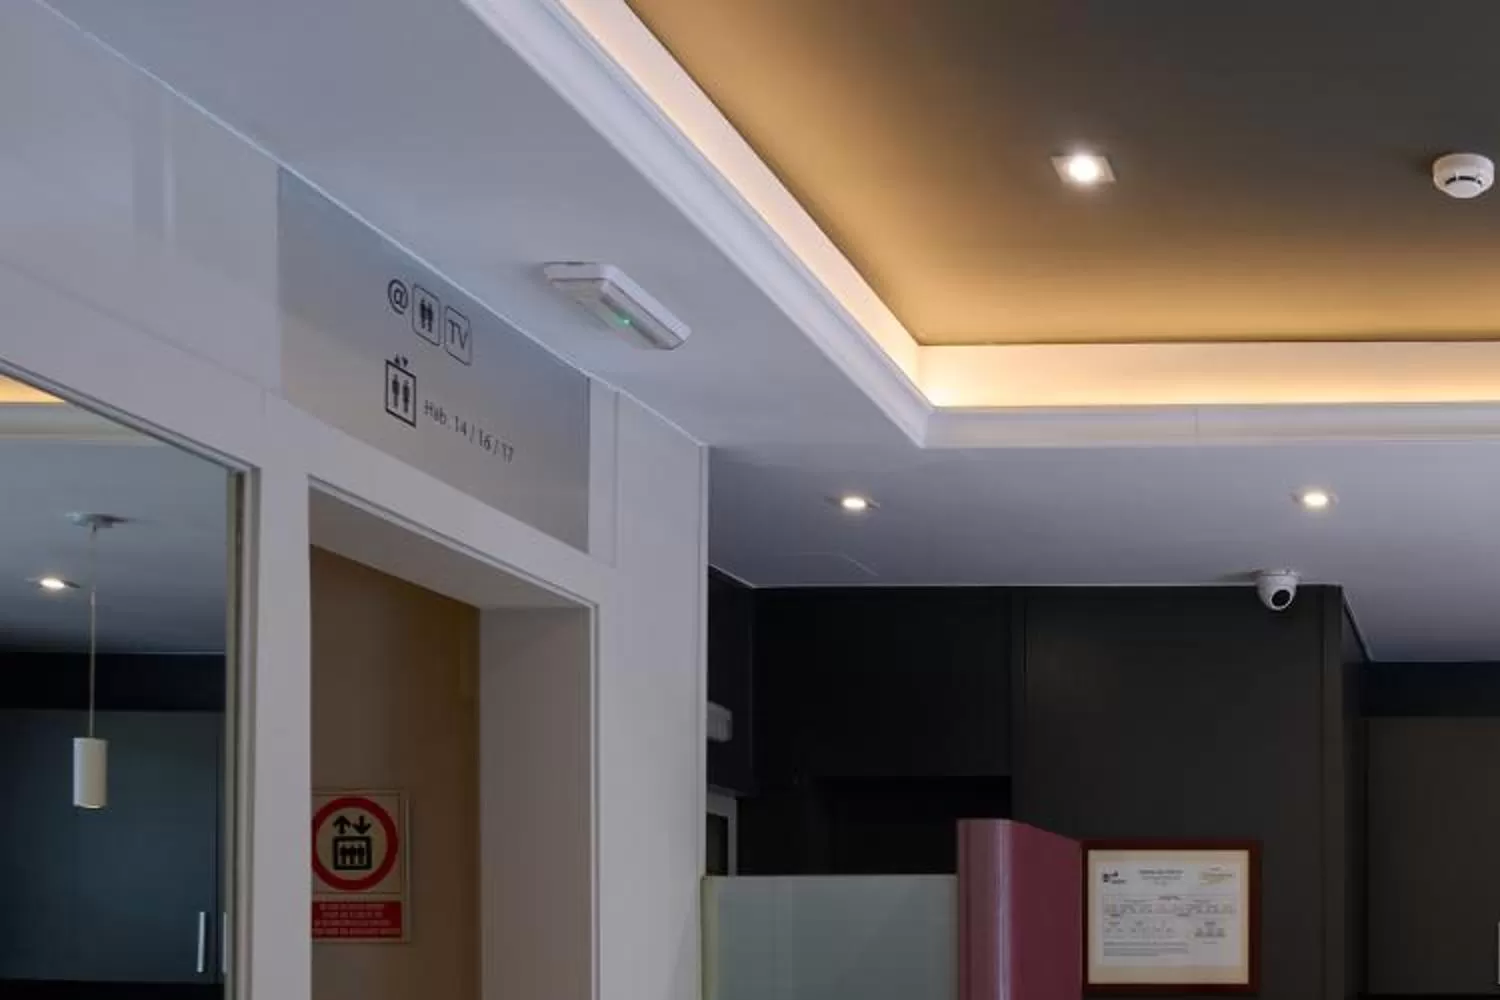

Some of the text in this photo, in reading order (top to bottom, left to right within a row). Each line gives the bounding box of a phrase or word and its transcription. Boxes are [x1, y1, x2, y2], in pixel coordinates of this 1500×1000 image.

[448, 319, 469, 350] TV
[455, 415, 467, 437] 14
[479, 428, 492, 451] 16
[501, 443, 514, 464] 17
